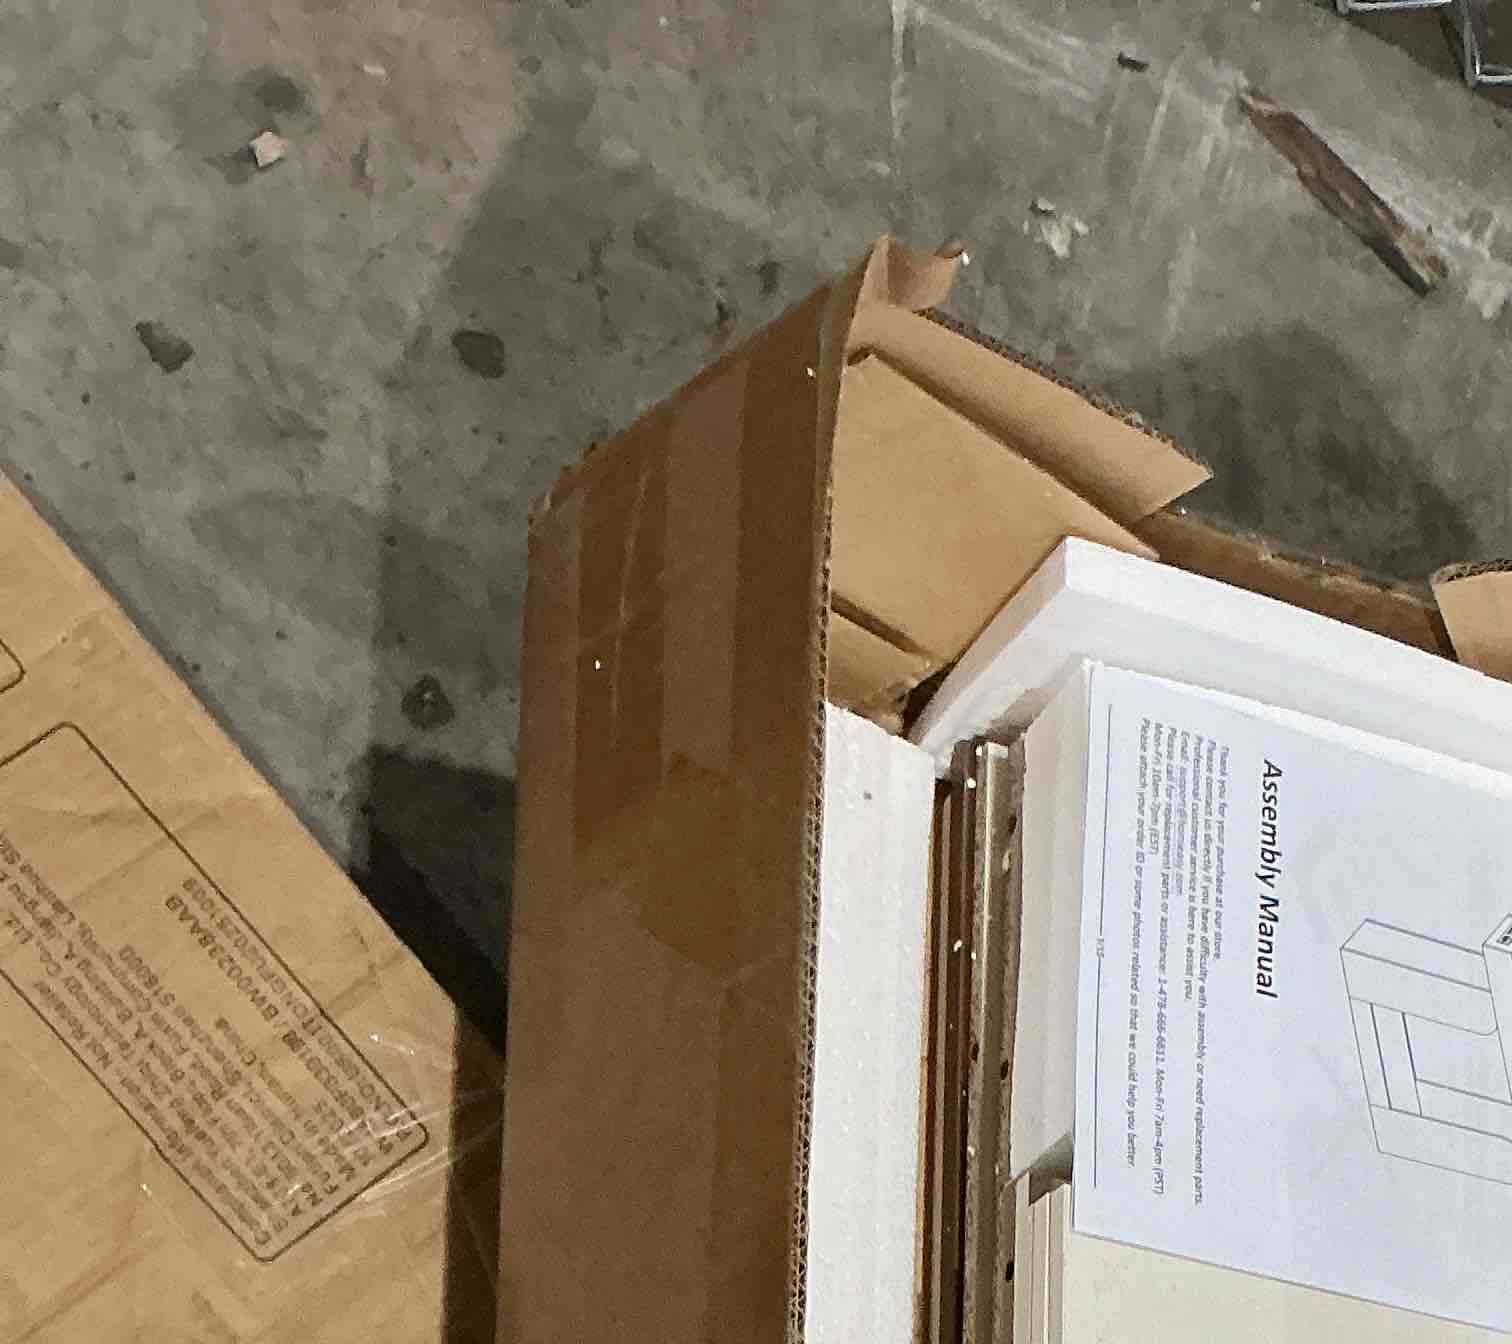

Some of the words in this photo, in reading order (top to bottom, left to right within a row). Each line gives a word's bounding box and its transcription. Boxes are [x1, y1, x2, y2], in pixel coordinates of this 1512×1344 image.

[1165, 762, 1176, 781] call
[1216, 778, 1225, 800] you
[1218, 801, 1227, 817] for
[1215, 819, 1224, 846] your
[1254, 758, 1284, 887] Assembly
[1215, 846, 1225, 894] purchase
[1159, 872, 1169, 900] parts
[1200, 885, 1209, 905] you
[1160, 901, 1168, 914] or
[1214, 895, 1223, 908] at
[1131, 910, 1144, 949] photos
[1186, 905, 1196, 931] here
[1200, 906, 1211, 934] have
[1214, 909, 1222, 929] our
[1186, 933, 1195, 945] to
[1255, 894, 1280, 999] Manual
[1129, 950, 1141, 992] related
[1197, 935, 1211, 982] difficulty
[1129, 992, 1139, 1006] so
[1197, 984, 1207, 1009] with
[1128, 1007, 1139, 1031] that
[1127, 1032, 1136, 1049] we
[1127, 1050, 1138, 1082] could
[1196, 1062, 1204, 1075] or
[1125, 1083, 1137, 1108] help
[1195, 1077, 1205, 1105] need
[1126, 1109, 1136, 1130] you
[1192, 1105, 1205, 1174] replacement
